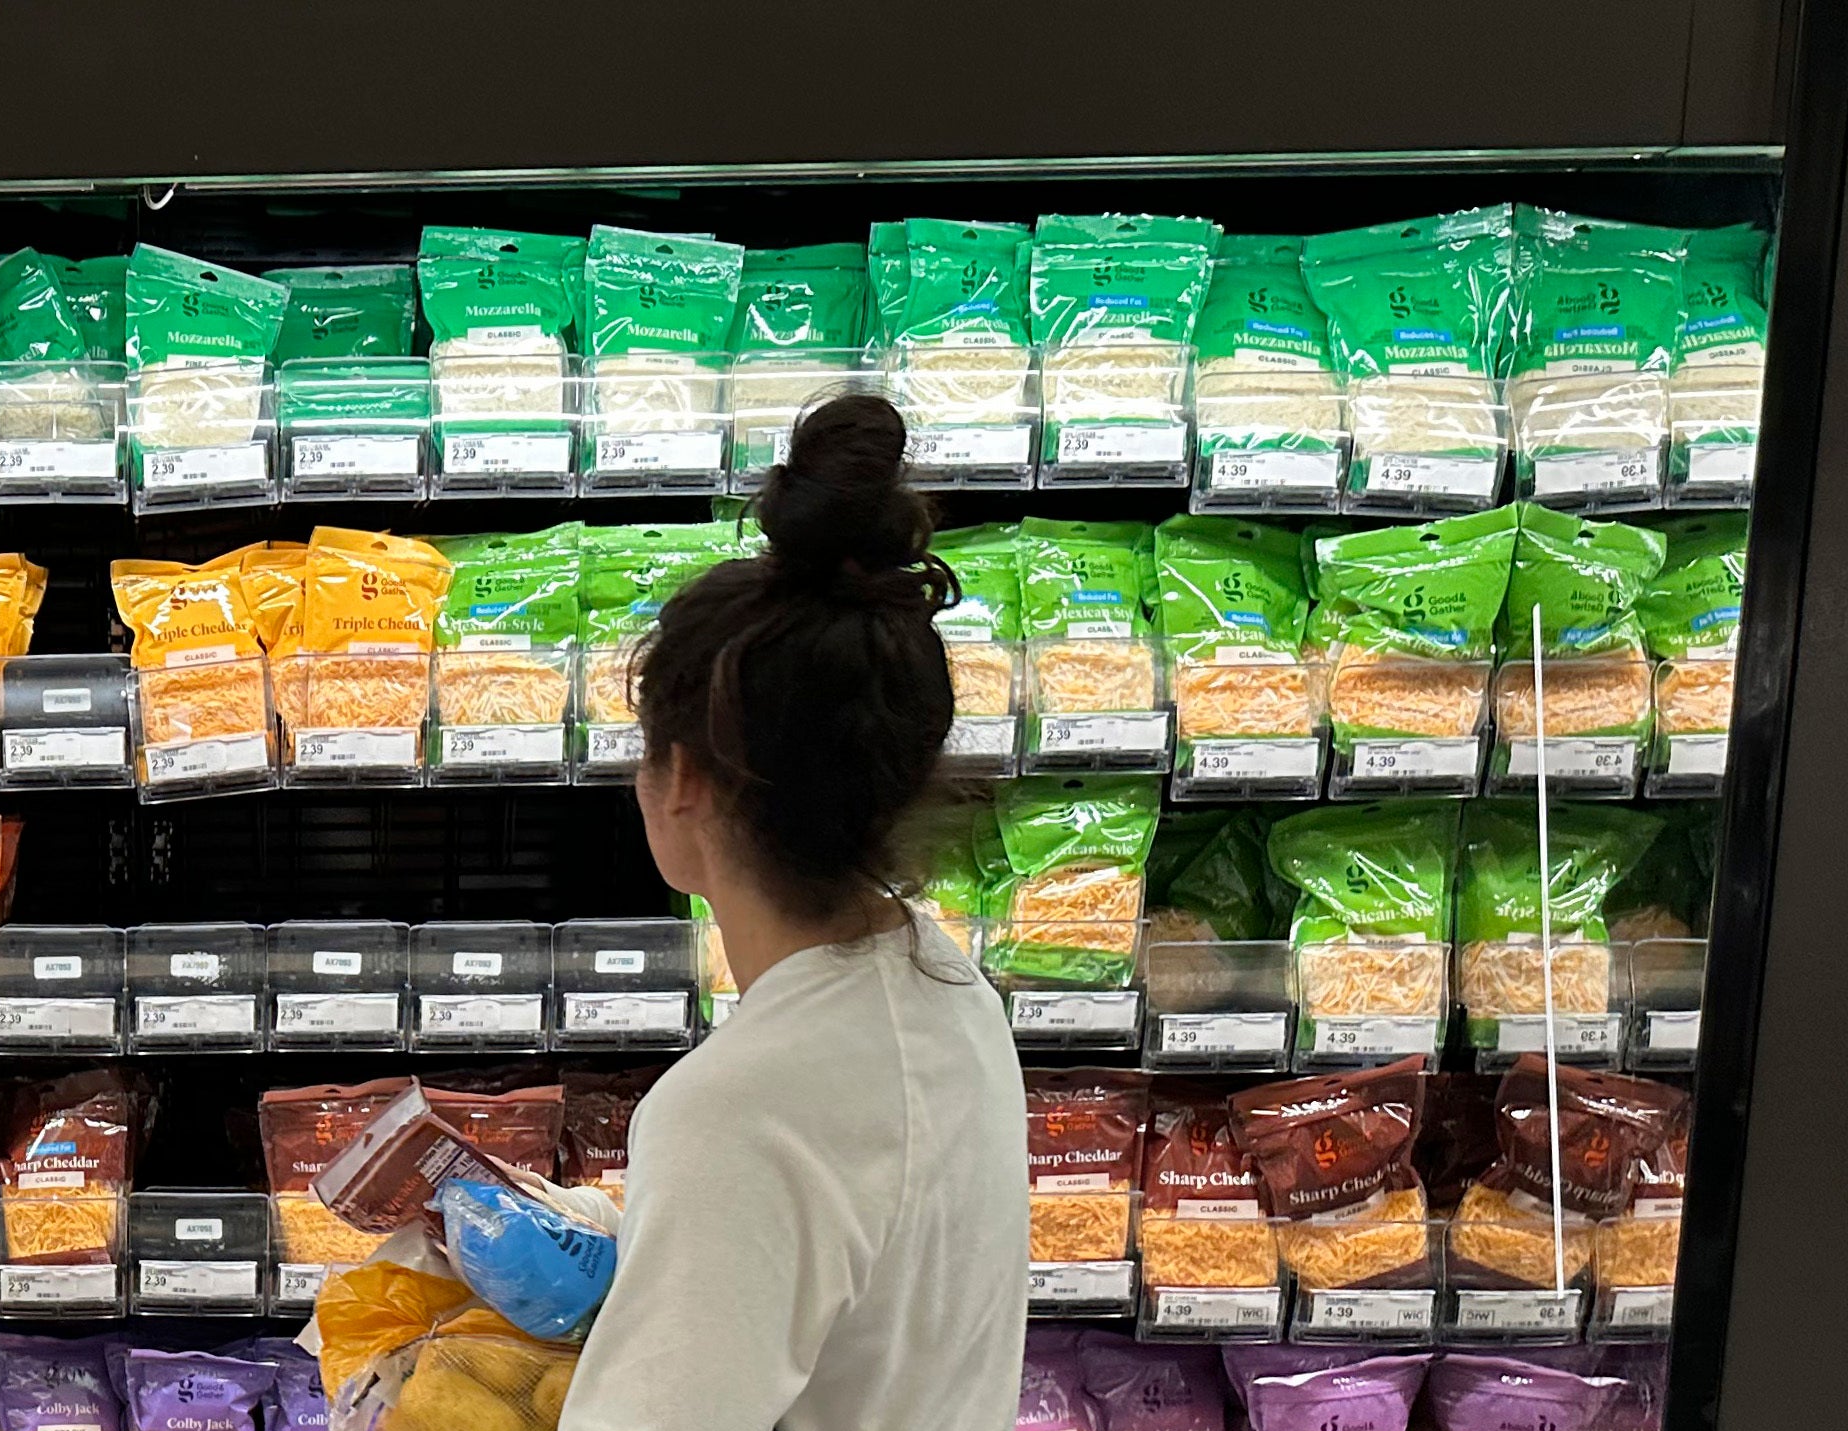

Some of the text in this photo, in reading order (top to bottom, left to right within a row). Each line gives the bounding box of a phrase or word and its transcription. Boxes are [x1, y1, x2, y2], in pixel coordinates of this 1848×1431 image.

[465, 304, 541, 317] Mozzarella
[627, 324, 699, 343] Mozzarella
[167, 331, 242, 349] Mozzarella
[1232, 332, 1321, 355] Mozzarella
[1385, 345, 1469, 359] Mozzarella
[1259, 355, 1297, 366] CLASSIC
[1064, 439, 1089, 449] 2.39
[1219, 465, 1247, 476] 4.39
[1382, 469, 1410, 481] 4.39
[1428, 595, 1467, 605] Good&
[1429, 604, 1466, 615] Gather
[185, 651, 218, 661] CLASSIC
[300, 743, 323, 755] 2.39
[1200, 757, 1229, 769] 4.39
[1367, 755, 1396, 769] 4.39
[430, 1011, 452, 1022] 2.39
[1168, 1032, 1196, 1042] 4.39
[1327, 1032, 1356, 1044] 4.39
[586, 1148, 625, 1160] Sharp
[44, 1157, 99, 1169] Cheddar
[1159, 1172, 1207, 1189] Sharp
[1200, 1205, 1238, 1213] CLASSIC
[1164, 1305, 1264, 1319] 4.39 WIC
[206, 1418, 234, 1431] Jack
